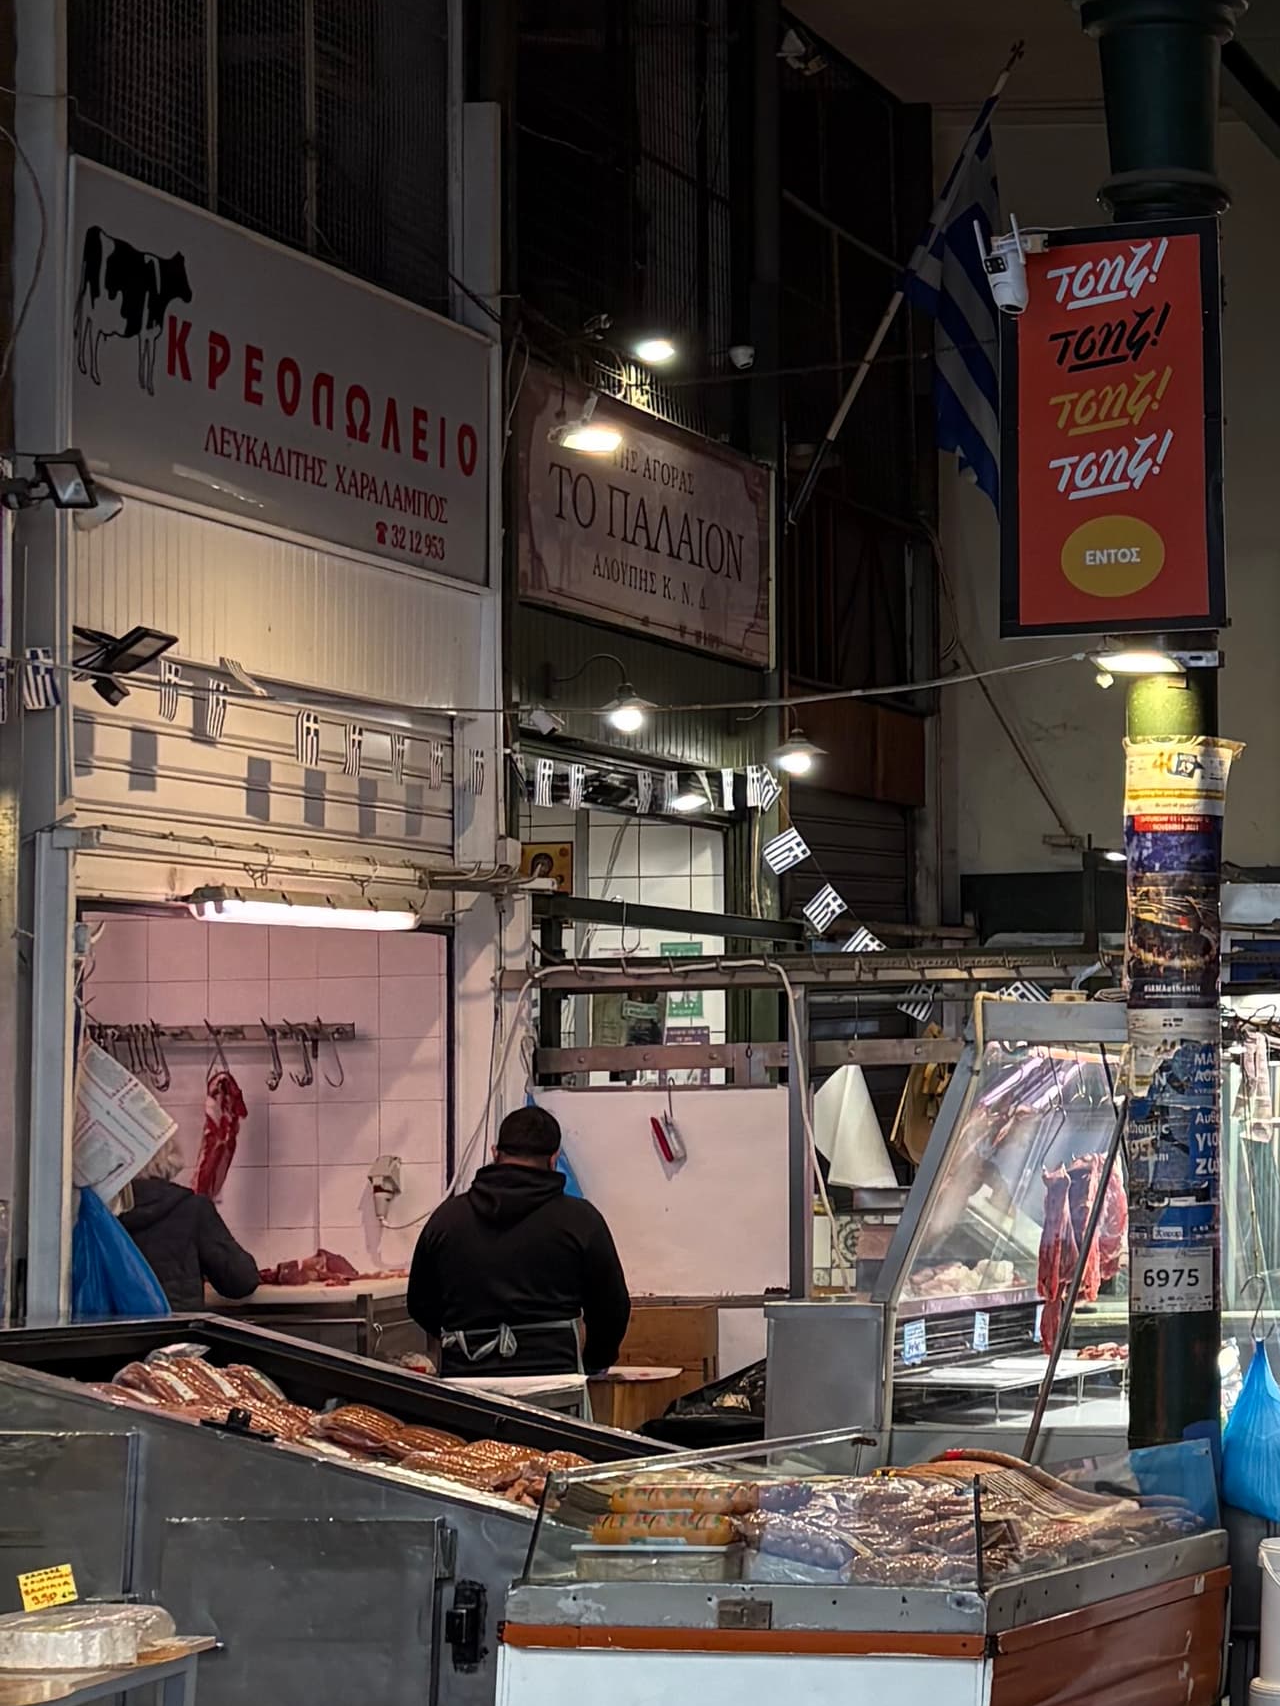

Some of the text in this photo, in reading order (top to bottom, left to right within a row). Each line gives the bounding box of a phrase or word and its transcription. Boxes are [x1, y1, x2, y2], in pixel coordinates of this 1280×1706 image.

[167, 314, 478, 477] ΚΡΕΟΠΩΛΕΙΟ
[204, 423, 449, 524] ΛΕΥΚΑΔΙΤΗΣ ΧΑΡΑΛΑΜΠΟΣ
[643, 457, 695, 495] ΑΓΟΡΑΣ
[548, 461, 745, 582] ΤΟ ΠΑΛΑΙΟΝ
[592, 553, 657, 595] ΑΛΟΥΠΗΣ
[1085, 547, 1141, 566] ΕΝΤΟΣ
[1143, 1268, 1200, 1287] 6975
